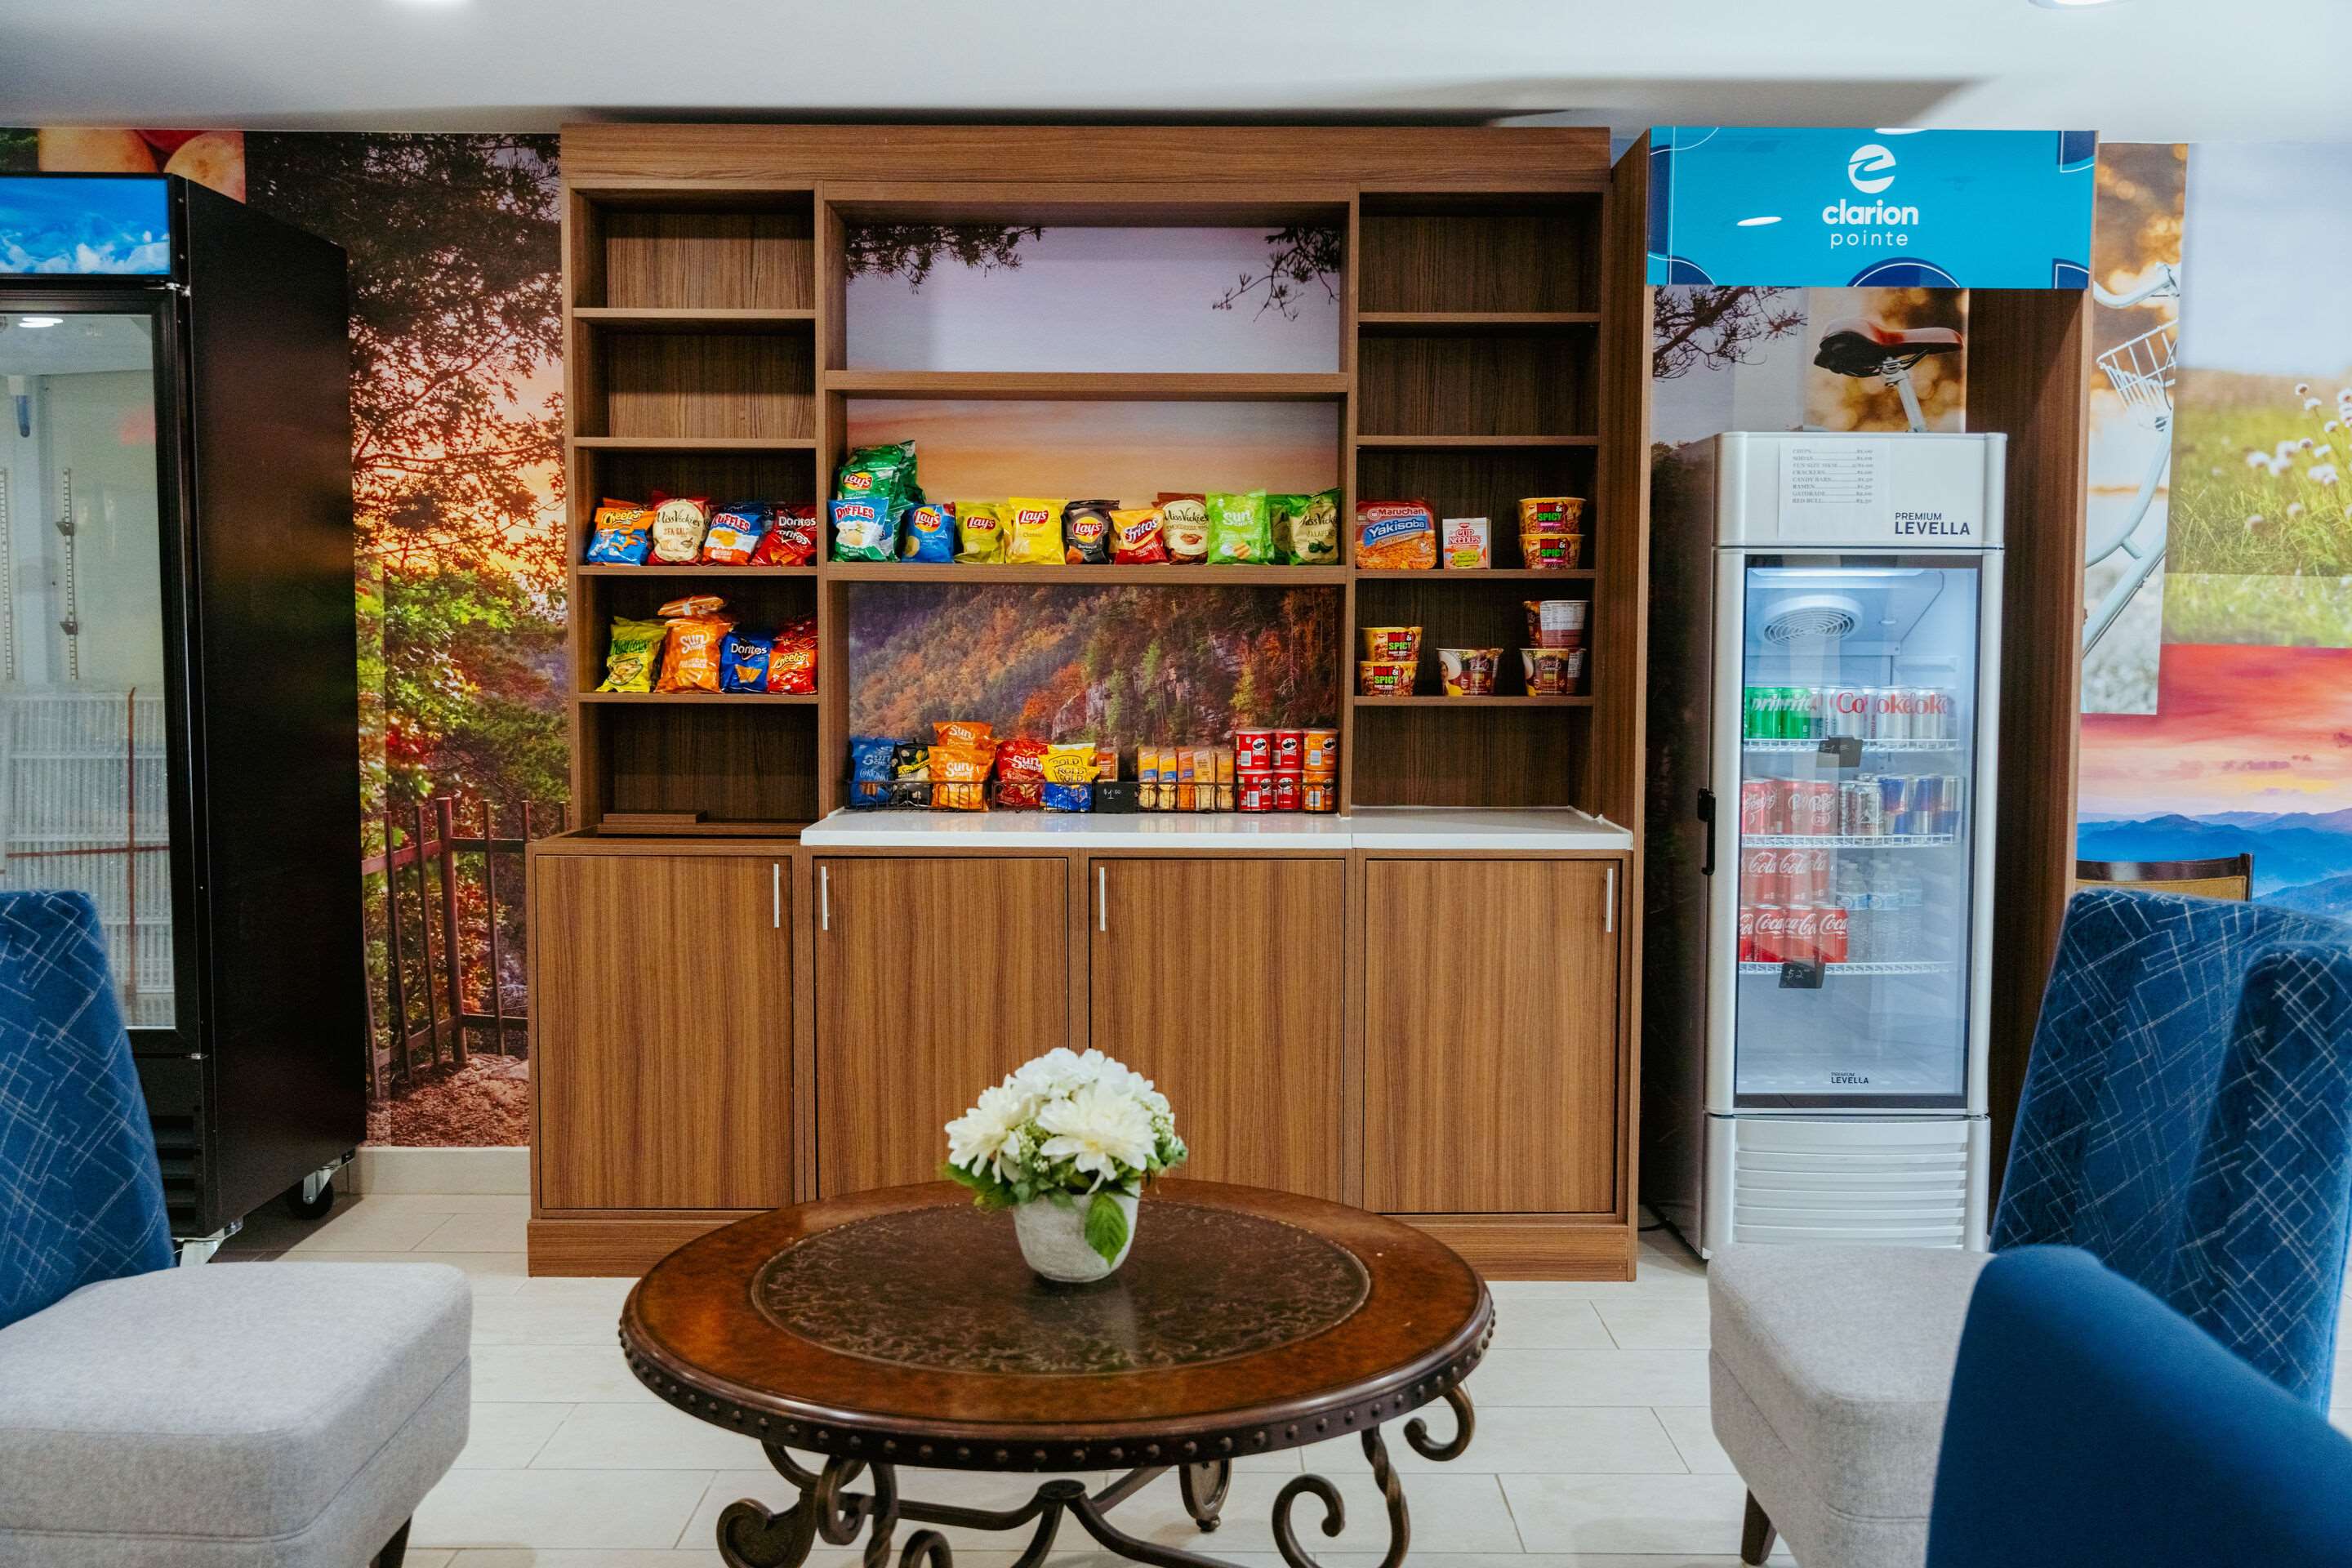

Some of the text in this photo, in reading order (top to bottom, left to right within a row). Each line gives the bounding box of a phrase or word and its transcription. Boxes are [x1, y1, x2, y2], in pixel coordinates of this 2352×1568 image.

[1822, 198, 1918, 225] clarion
[1830, 230, 1909, 248] pointe
[1378, 508, 1424, 516] Maruchan
[1538, 512, 1563, 521] SPICY
[1895, 512, 1942, 520] PREMIUM
[777, 516, 816, 527] Doritos
[1125, 519, 1158, 543] Fritos
[1368, 519, 1425, 538] Yakisoba
[1895, 521, 1971, 535] LEVELLA
[776, 529, 808, 546] oritos
[1448, 536, 1481, 545] NOODLES
[1541, 549, 1566, 557] SPICY
[730, 643, 768, 655] Doritos
[1388, 642, 1412, 651] SPICY
[1374, 675, 1399, 684] SPICY
[1011, 755, 1040, 769] Sun
